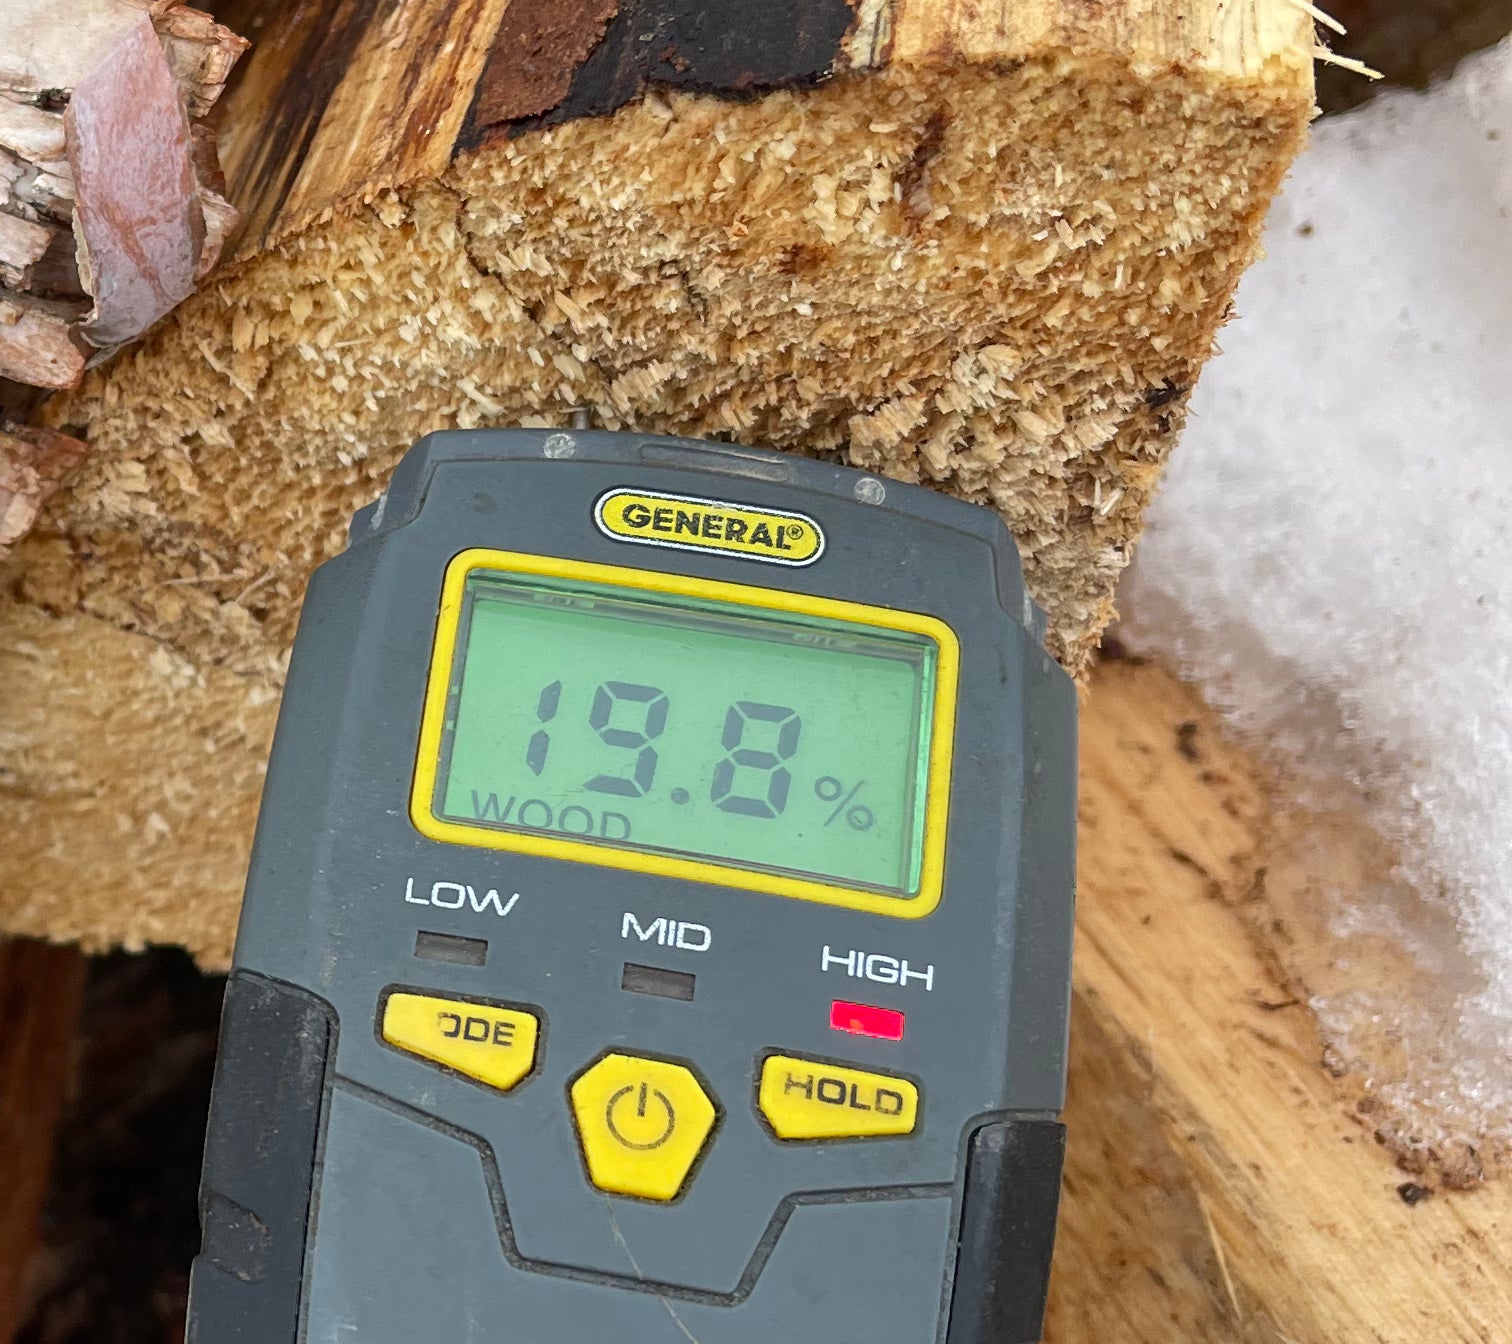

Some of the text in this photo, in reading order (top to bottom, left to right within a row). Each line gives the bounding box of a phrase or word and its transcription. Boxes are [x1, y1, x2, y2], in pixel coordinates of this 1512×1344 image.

[469, 789, 632, 843] WOOD
[404, 878, 520, 917] LOW
[621, 912, 712, 953] MID
[821, 945, 935, 992] HIGH
[437, 1011, 516, 1047] ODE
[784, 1072, 904, 1119] HOLD
